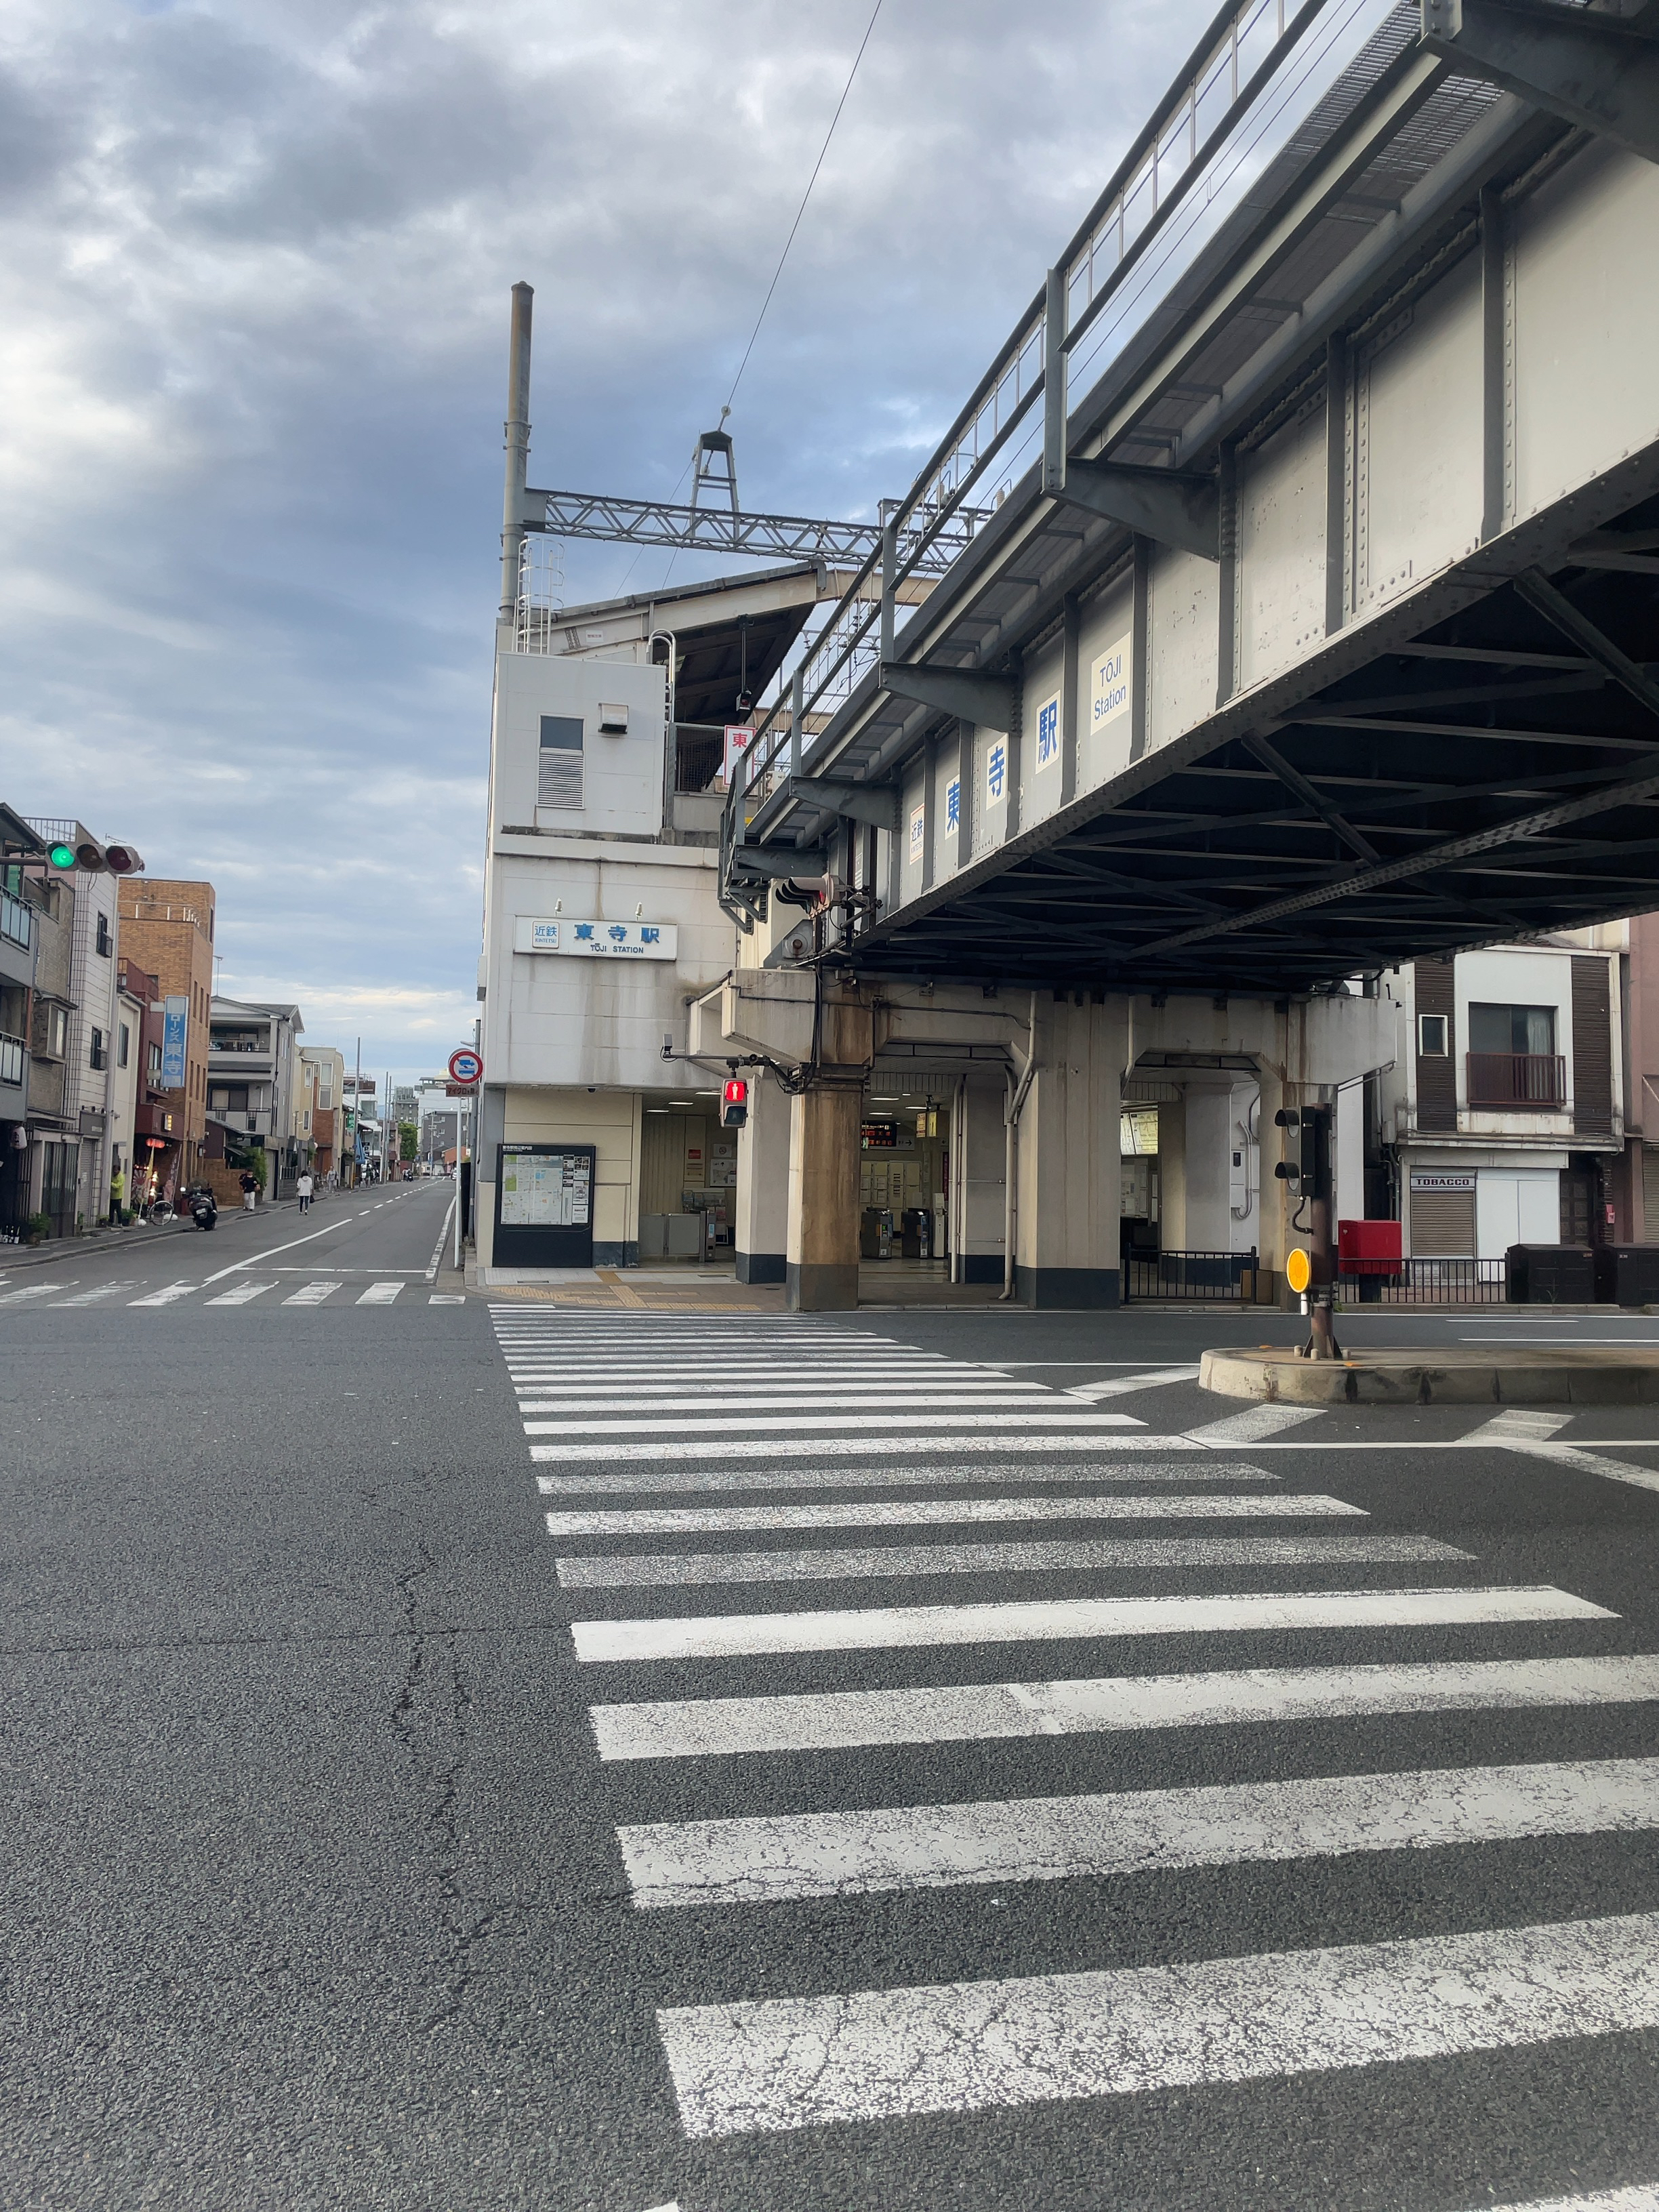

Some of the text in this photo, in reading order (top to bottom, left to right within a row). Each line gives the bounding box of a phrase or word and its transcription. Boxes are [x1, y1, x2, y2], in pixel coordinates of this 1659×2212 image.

[1099, 654, 1121, 687] TŌJI
[1094, 685, 1126, 720] Station
[988, 745, 1004, 797] 寺
[1038, 699, 1057, 764] 駅
[535, 926, 557, 937] 近鉄
[573, 923, 659, 943] 東寺駅
[590, 943, 644, 954] TŌJI STATION
